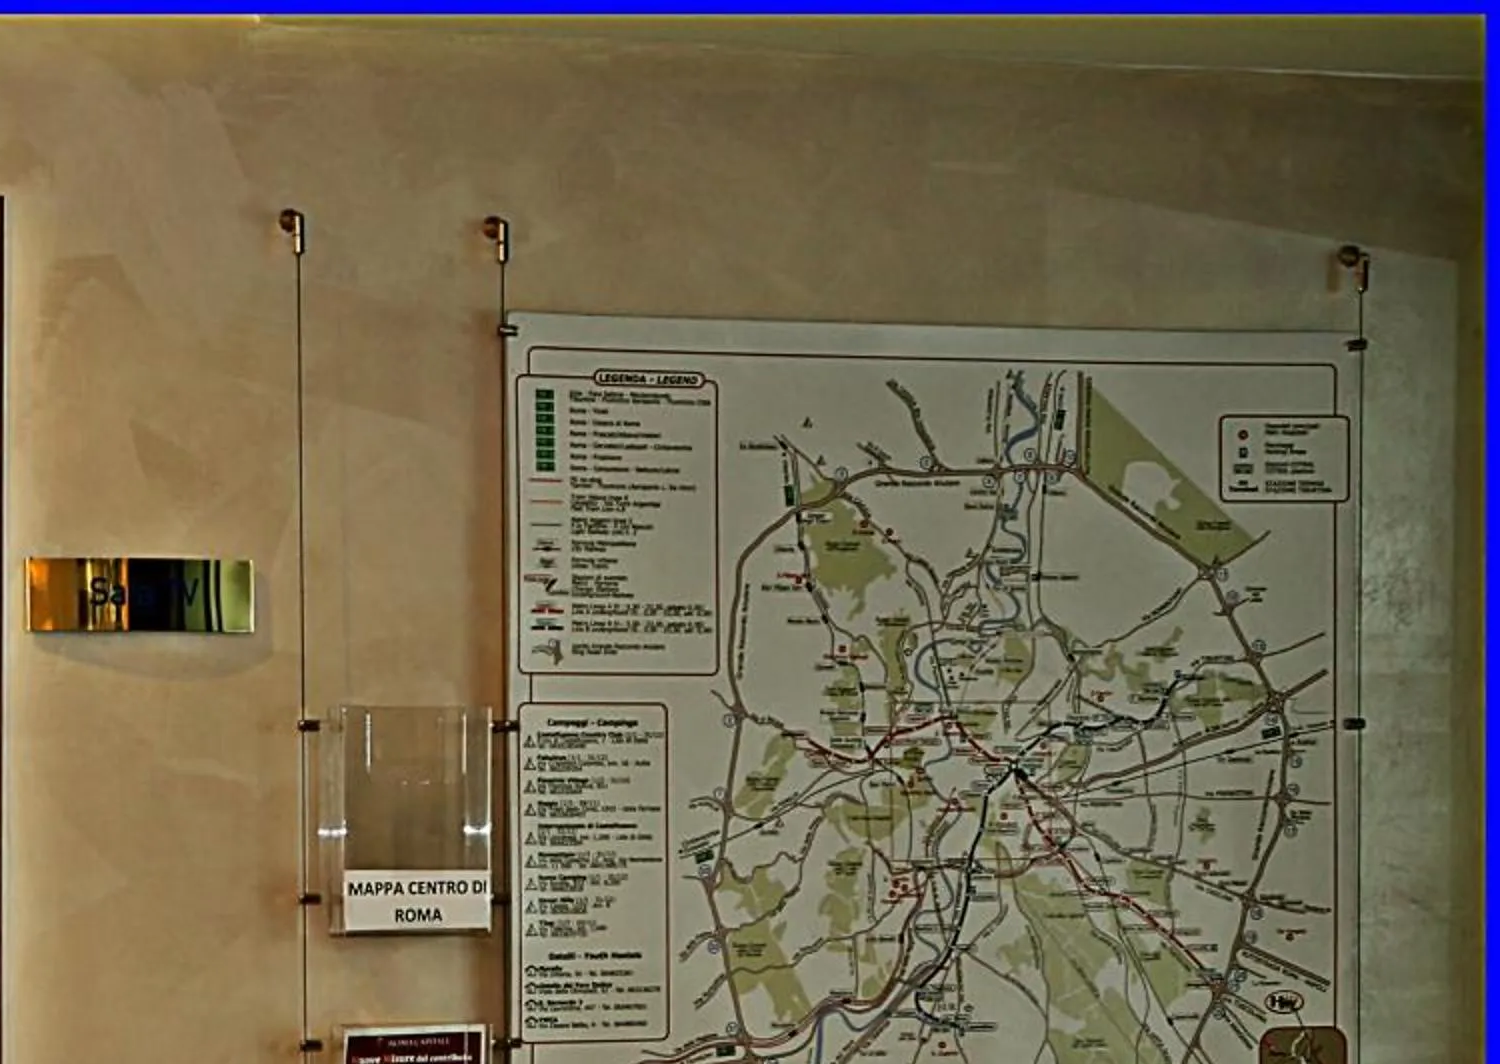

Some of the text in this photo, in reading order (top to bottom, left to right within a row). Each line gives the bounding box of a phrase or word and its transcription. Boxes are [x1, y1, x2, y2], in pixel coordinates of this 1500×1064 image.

[599, 373, 699, 385] LEGENDA LEGEND
[348, 879, 487, 896] MAPPA CENTRO DI
[394, 907, 443, 922] ROMA
